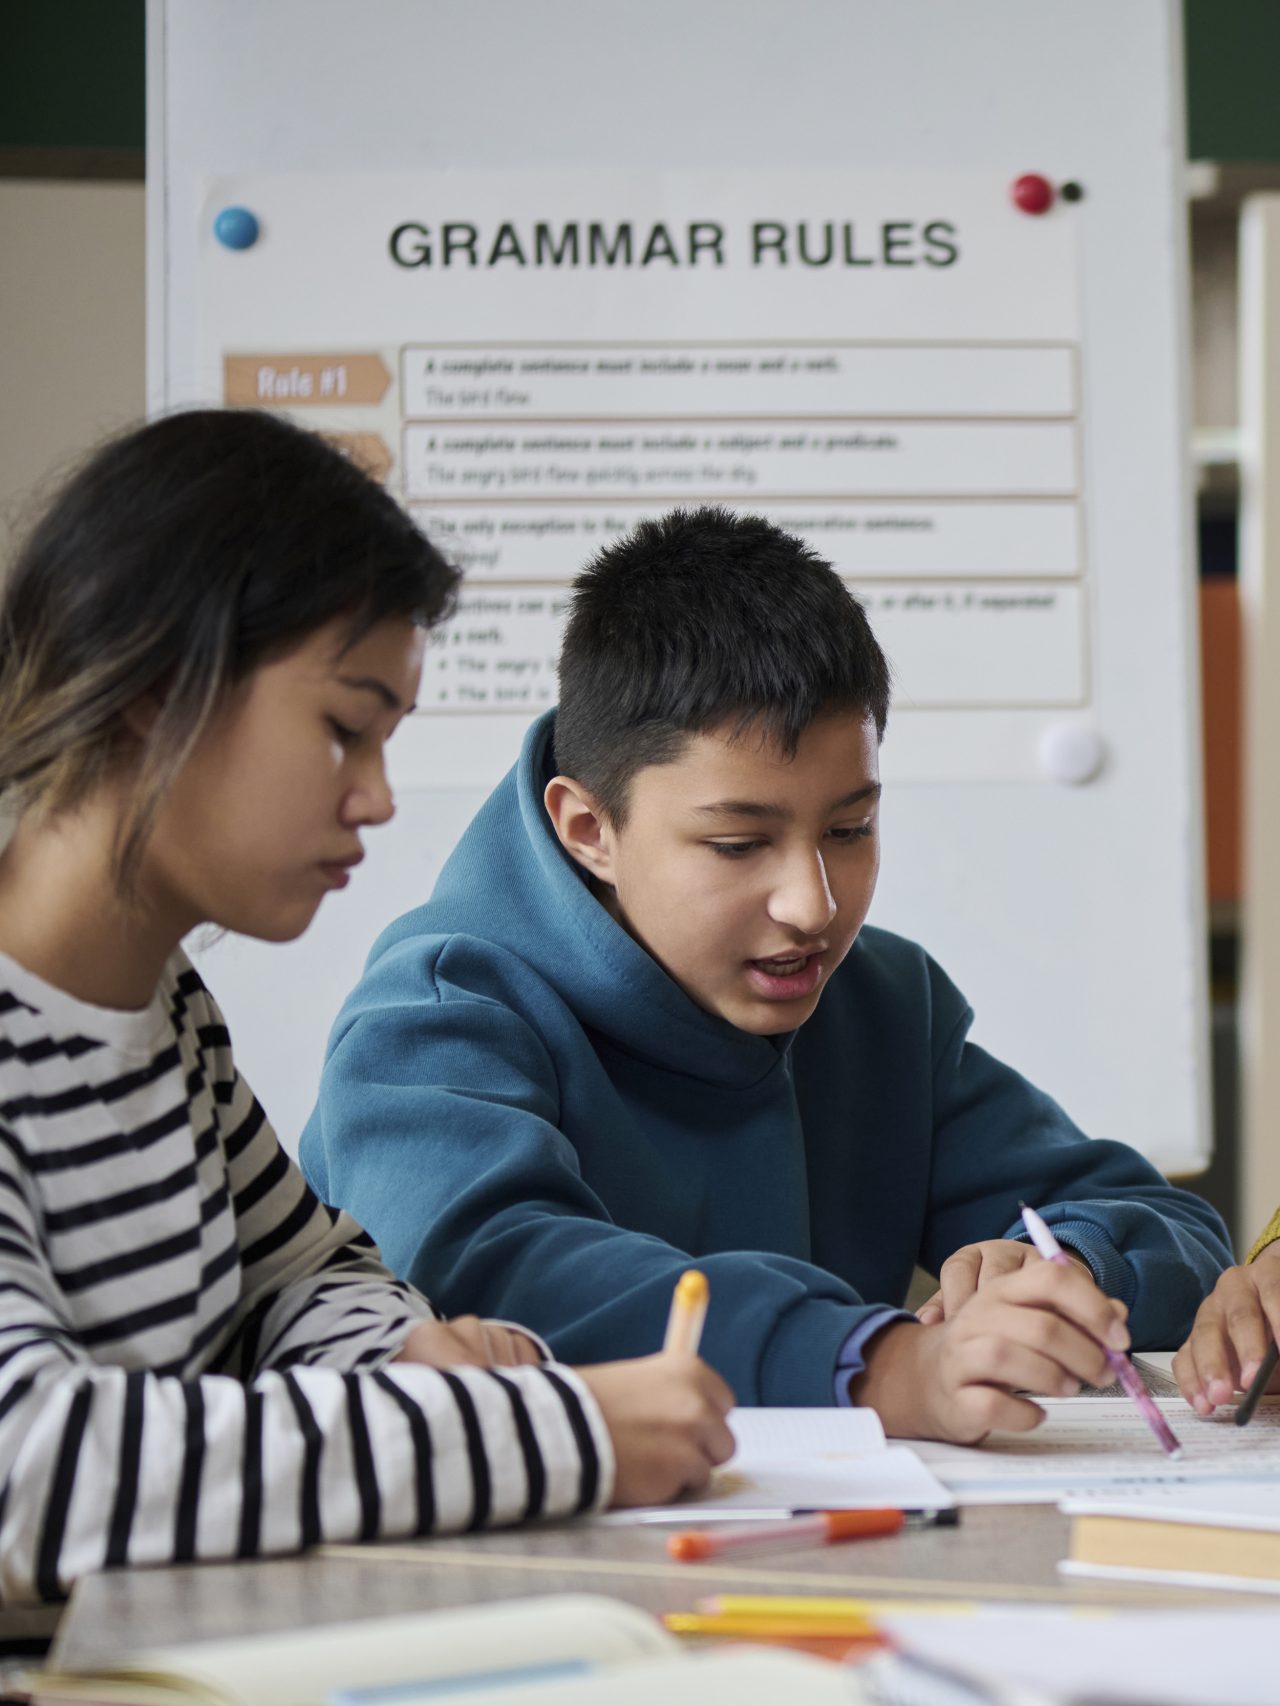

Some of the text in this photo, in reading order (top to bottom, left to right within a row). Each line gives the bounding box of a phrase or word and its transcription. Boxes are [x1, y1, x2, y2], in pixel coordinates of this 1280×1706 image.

[388, 221, 959, 270] GRAMMAR RULES
[442, 356, 514, 378] complete
[520, 356, 590, 375] sentence
[596, 356, 633, 374] must
[640, 355, 695, 374] include
[758, 355, 786, 374] and
[256, 365, 348, 398] Rule #1
[426, 387, 453, 406] The
[459, 387, 490, 406] bird
[444, 434, 516, 457] complete
[522, 434, 592, 453] sentence
[599, 434, 635, 452] must
[642, 432, 697, 452] include
[718, 432, 771, 455] subject
[779, 432, 806, 451] and
[428, 465, 455, 483] The
[462, 468, 506, 488] angry
[511, 466, 541, 483] bird
[547, 463, 579, 482] flew
[701, 462, 724, 481] the
[429, 518, 456, 536] The
[463, 518, 496, 540] only
[501, 517, 576, 538] exception
[777, 514, 857, 533] mperative
[982, 592, 1056, 613] separated
[457, 657, 487, 672] The
[496, 660, 541, 676] angry
[458, 685, 488, 700] The
[496, 684, 530, 700] bird
